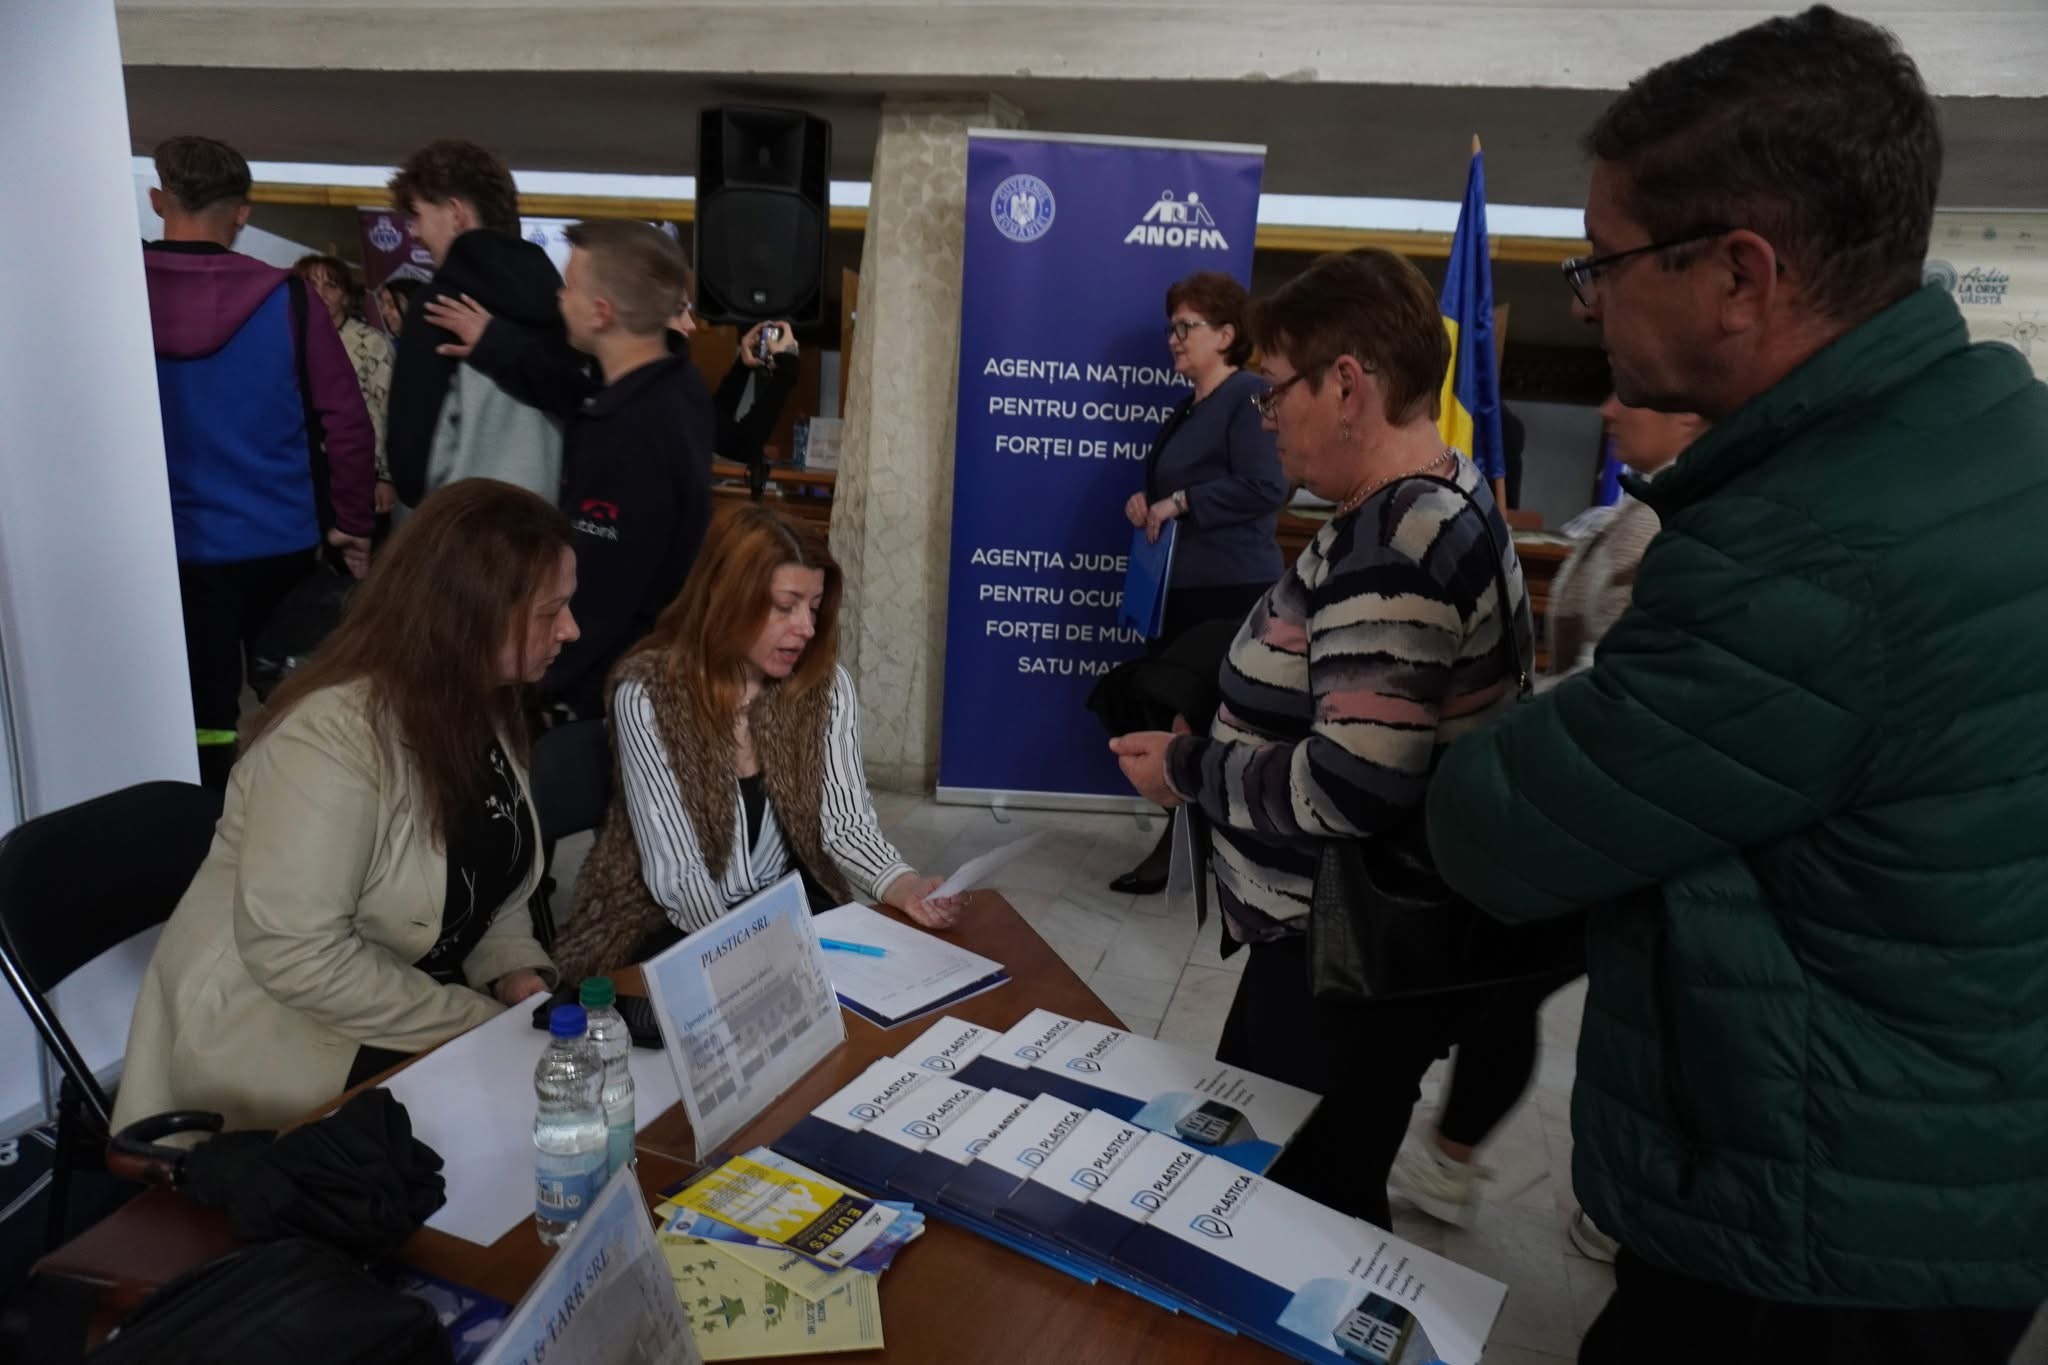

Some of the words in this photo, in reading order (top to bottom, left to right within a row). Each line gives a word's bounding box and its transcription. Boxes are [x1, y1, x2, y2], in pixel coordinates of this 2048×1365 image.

[1123, 224, 1230, 251] ANOFM
[988, 395, 1076, 419] PENTRU
[995, 434, 1073, 461] FORȚEI
[1078, 440, 1107, 459] DE
[1069, 552, 1131, 573] JUDE
[979, 583, 1065, 606] PENTRU
[985, 619, 1060, 644] FORȚEI
[1065, 624, 1093, 642] DE
[1017, 656, 1073, 676] SATU
[700, 930, 752, 969] PLASTICA
[752, 913, 771, 937] SRL
[940, 1026, 980, 1058] PLASTICA
[1034, 1019, 1071, 1048] PLASTICA
[1085, 1029, 1122, 1060] PLASTICA
[872, 1070, 920, 1105] PLASTICA
[926, 1087, 973, 1123] PLASTICA
[1039, 1109, 1083, 1149] PLASTICA
[1092, 1127, 1135, 1170] PLASTICA
[1152, 1150, 1195, 1193] PLASTICA
[1210, 1174, 1253, 1217] PLASTICA
[809, 1207, 863, 1251] EURES
[545, 1283, 587, 1343] TARR
[584, 1246, 611, 1288] SRL
